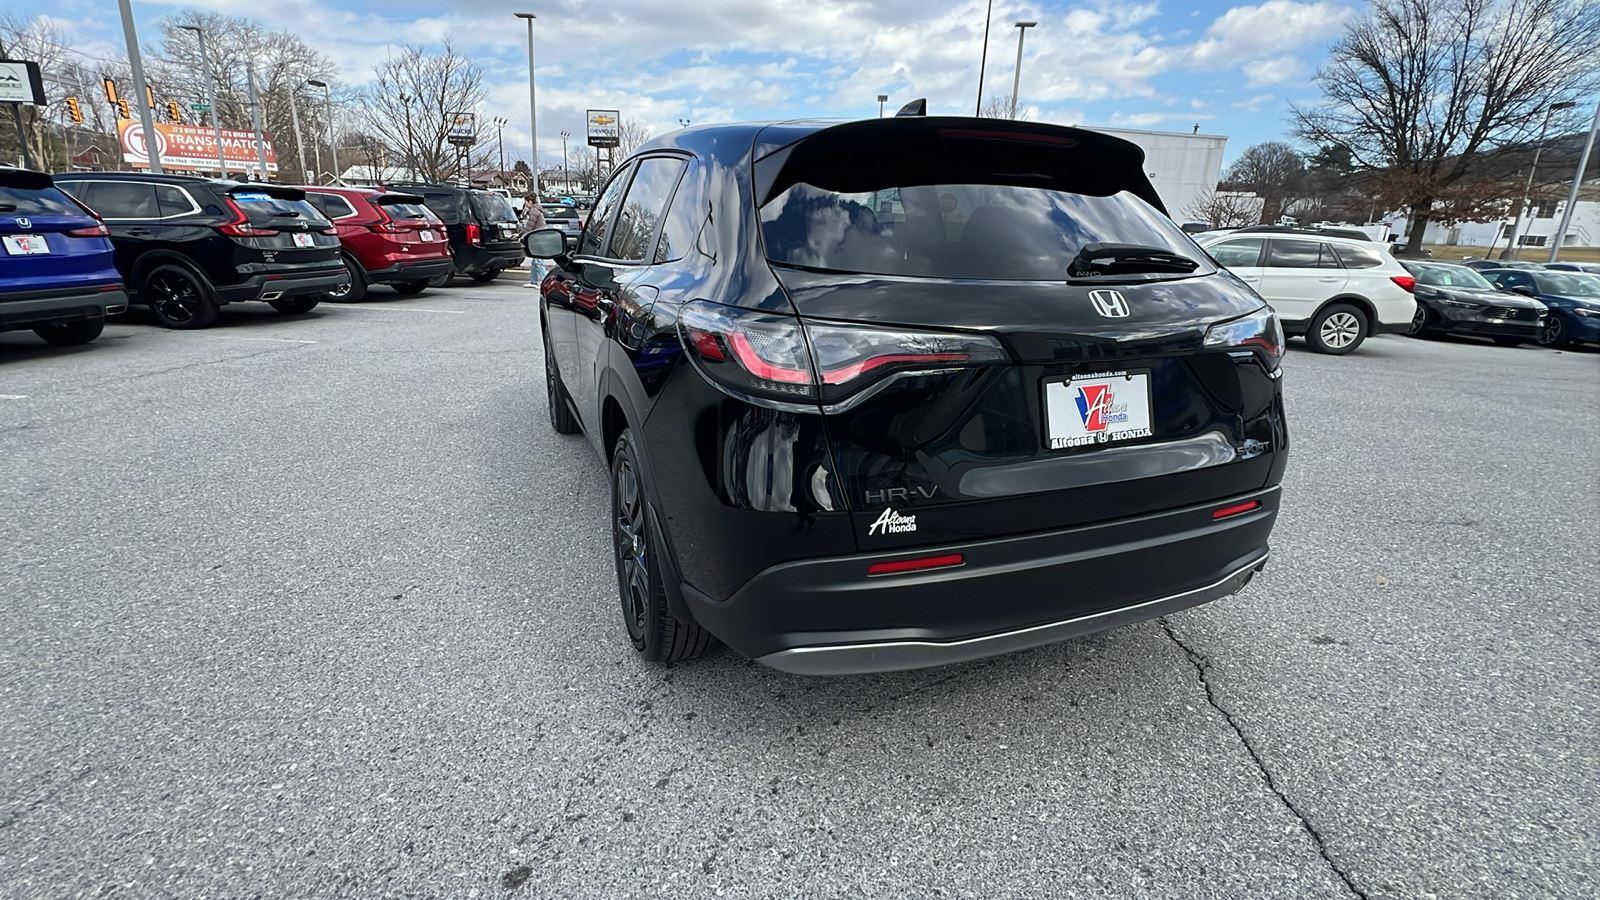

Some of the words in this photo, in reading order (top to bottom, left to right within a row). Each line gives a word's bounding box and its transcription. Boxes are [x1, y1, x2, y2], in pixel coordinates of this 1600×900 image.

[1072, 371, 1127, 380] altoonahonda.com
[1102, 413, 1127, 423] Honda
[1051, 435, 1095, 449] Altoona
[1112, 428, 1152, 441] HONDA
[1237, 441, 1269, 454] SPORT
[865, 485, 938, 503] HR-V
[889, 523, 917, 533] Honda
